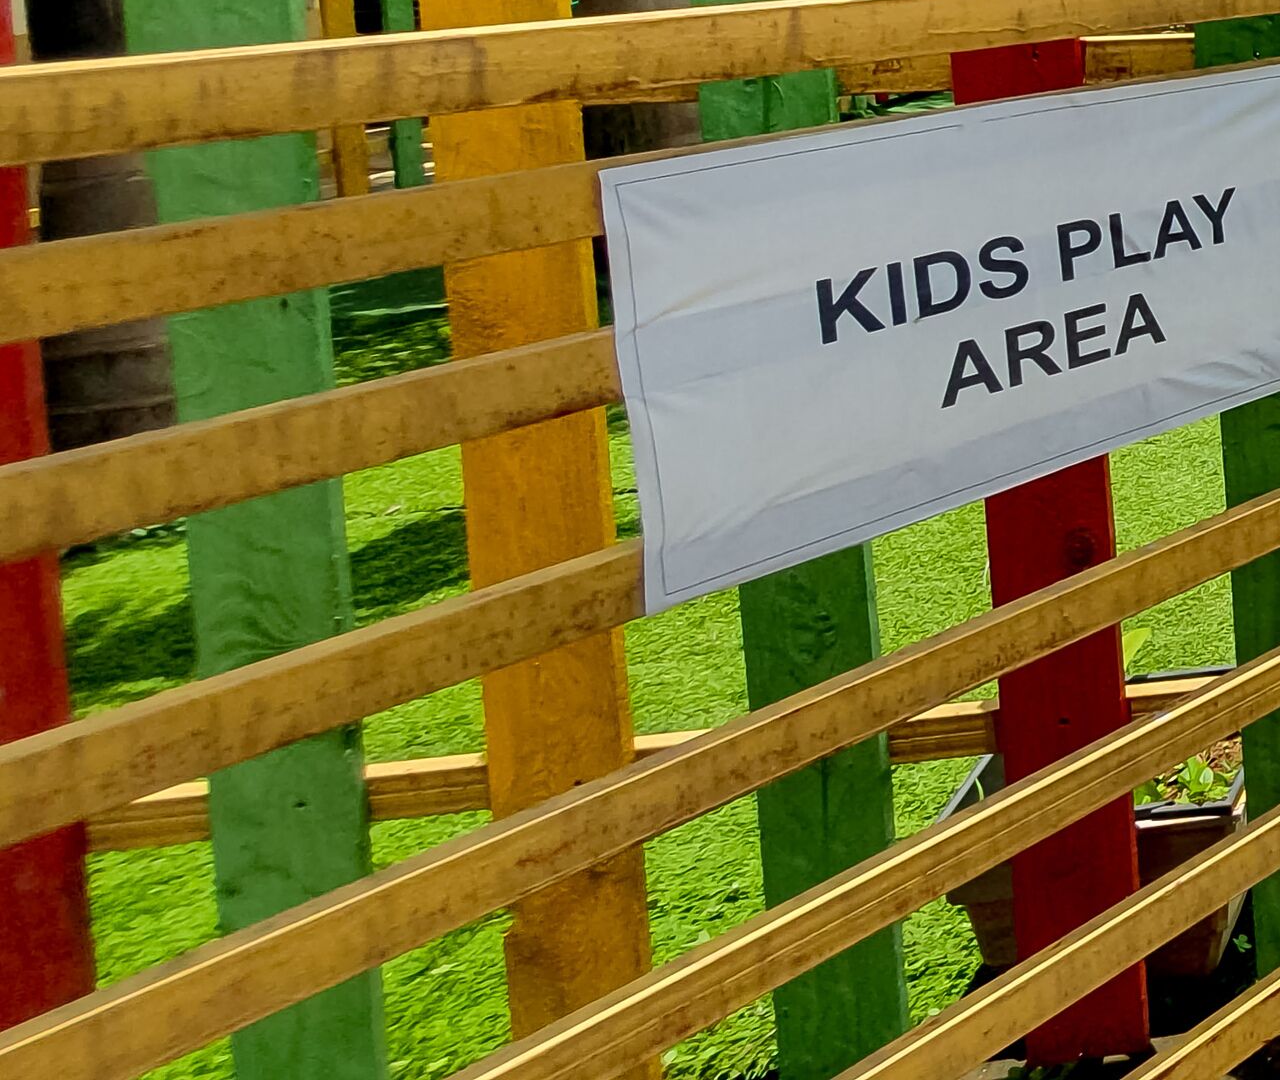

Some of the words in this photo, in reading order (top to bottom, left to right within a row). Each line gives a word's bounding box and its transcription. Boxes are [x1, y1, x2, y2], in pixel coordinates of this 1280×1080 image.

[816, 236, 1029, 344] KIDS
[1057, 187, 1235, 281] PLAY
[942, 293, 1166, 408] AREA
